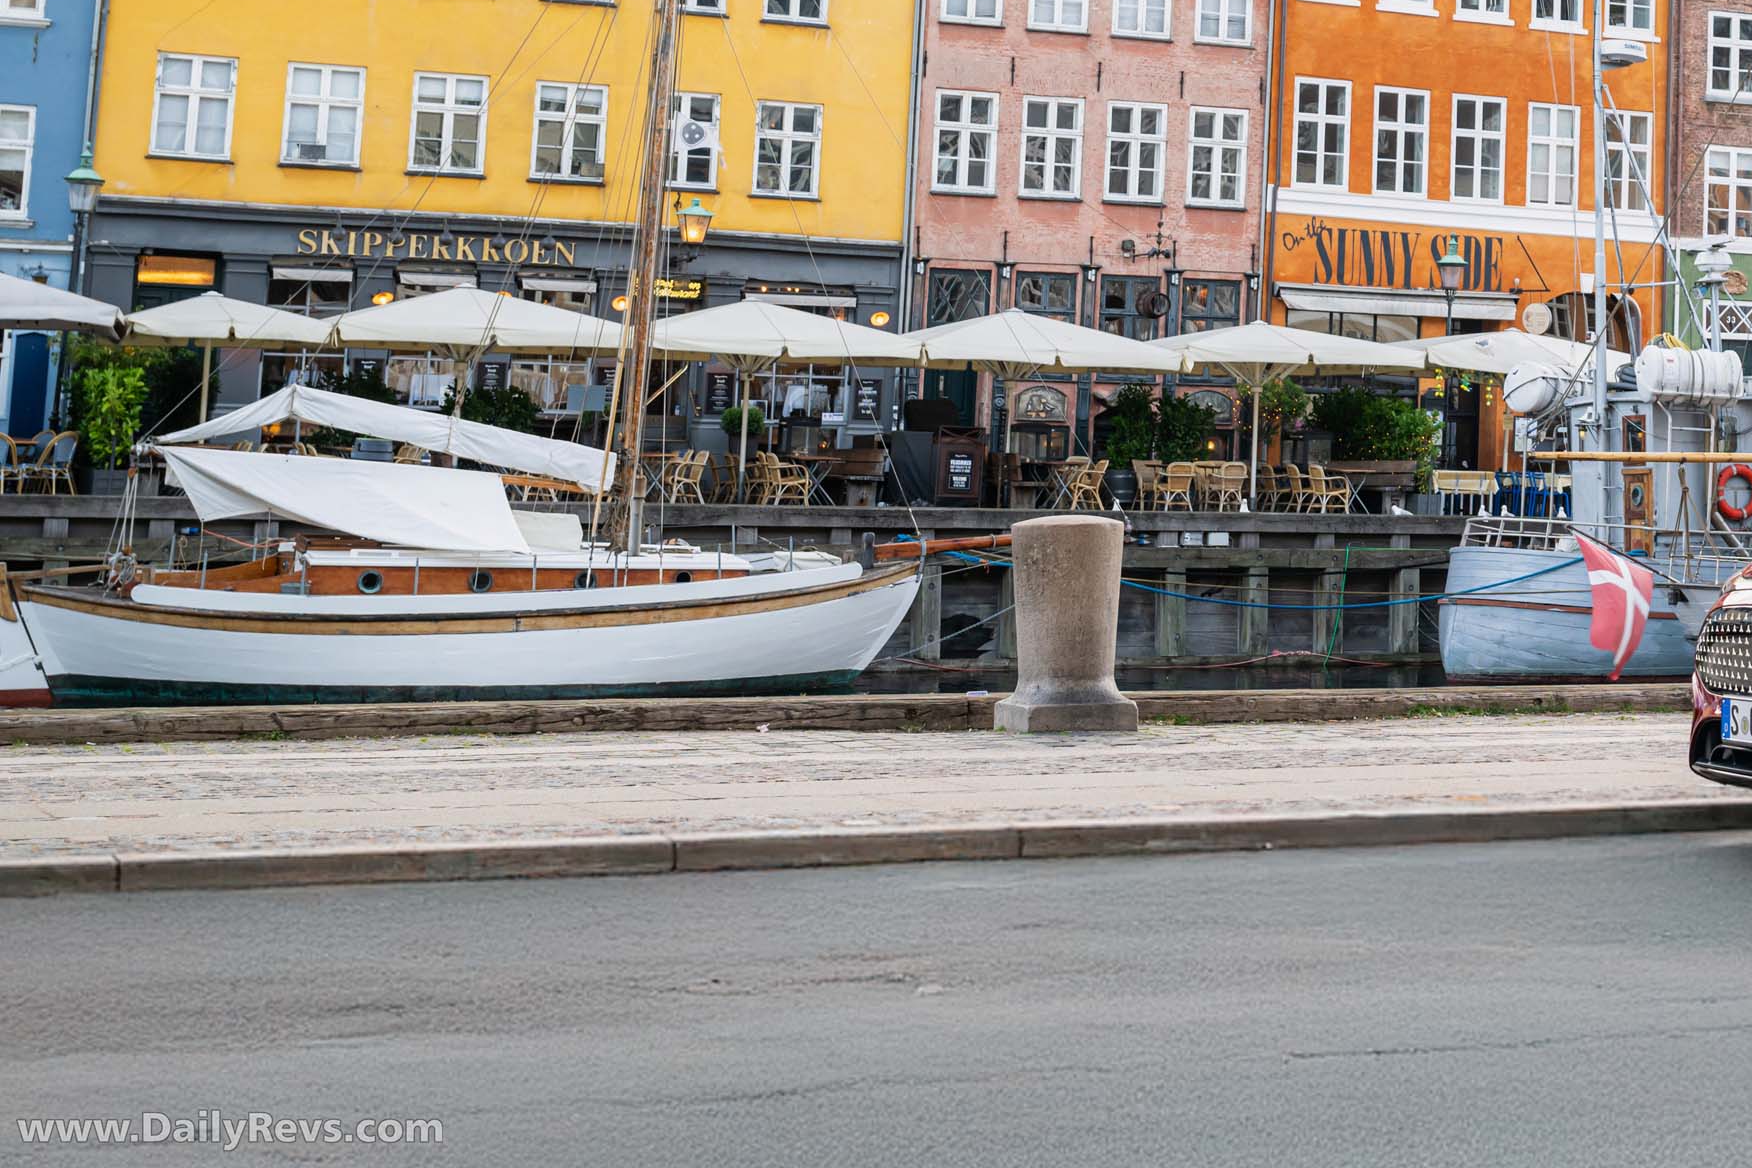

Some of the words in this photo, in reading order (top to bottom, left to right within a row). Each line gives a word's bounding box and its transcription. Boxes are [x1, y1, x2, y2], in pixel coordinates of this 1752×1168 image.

[1314, 227, 1421, 289] SUNNY
[1428, 233, 1504, 291] SDE
[1726, 315, 1737, 324] 33
[1731, 704, 1739, 736] S
